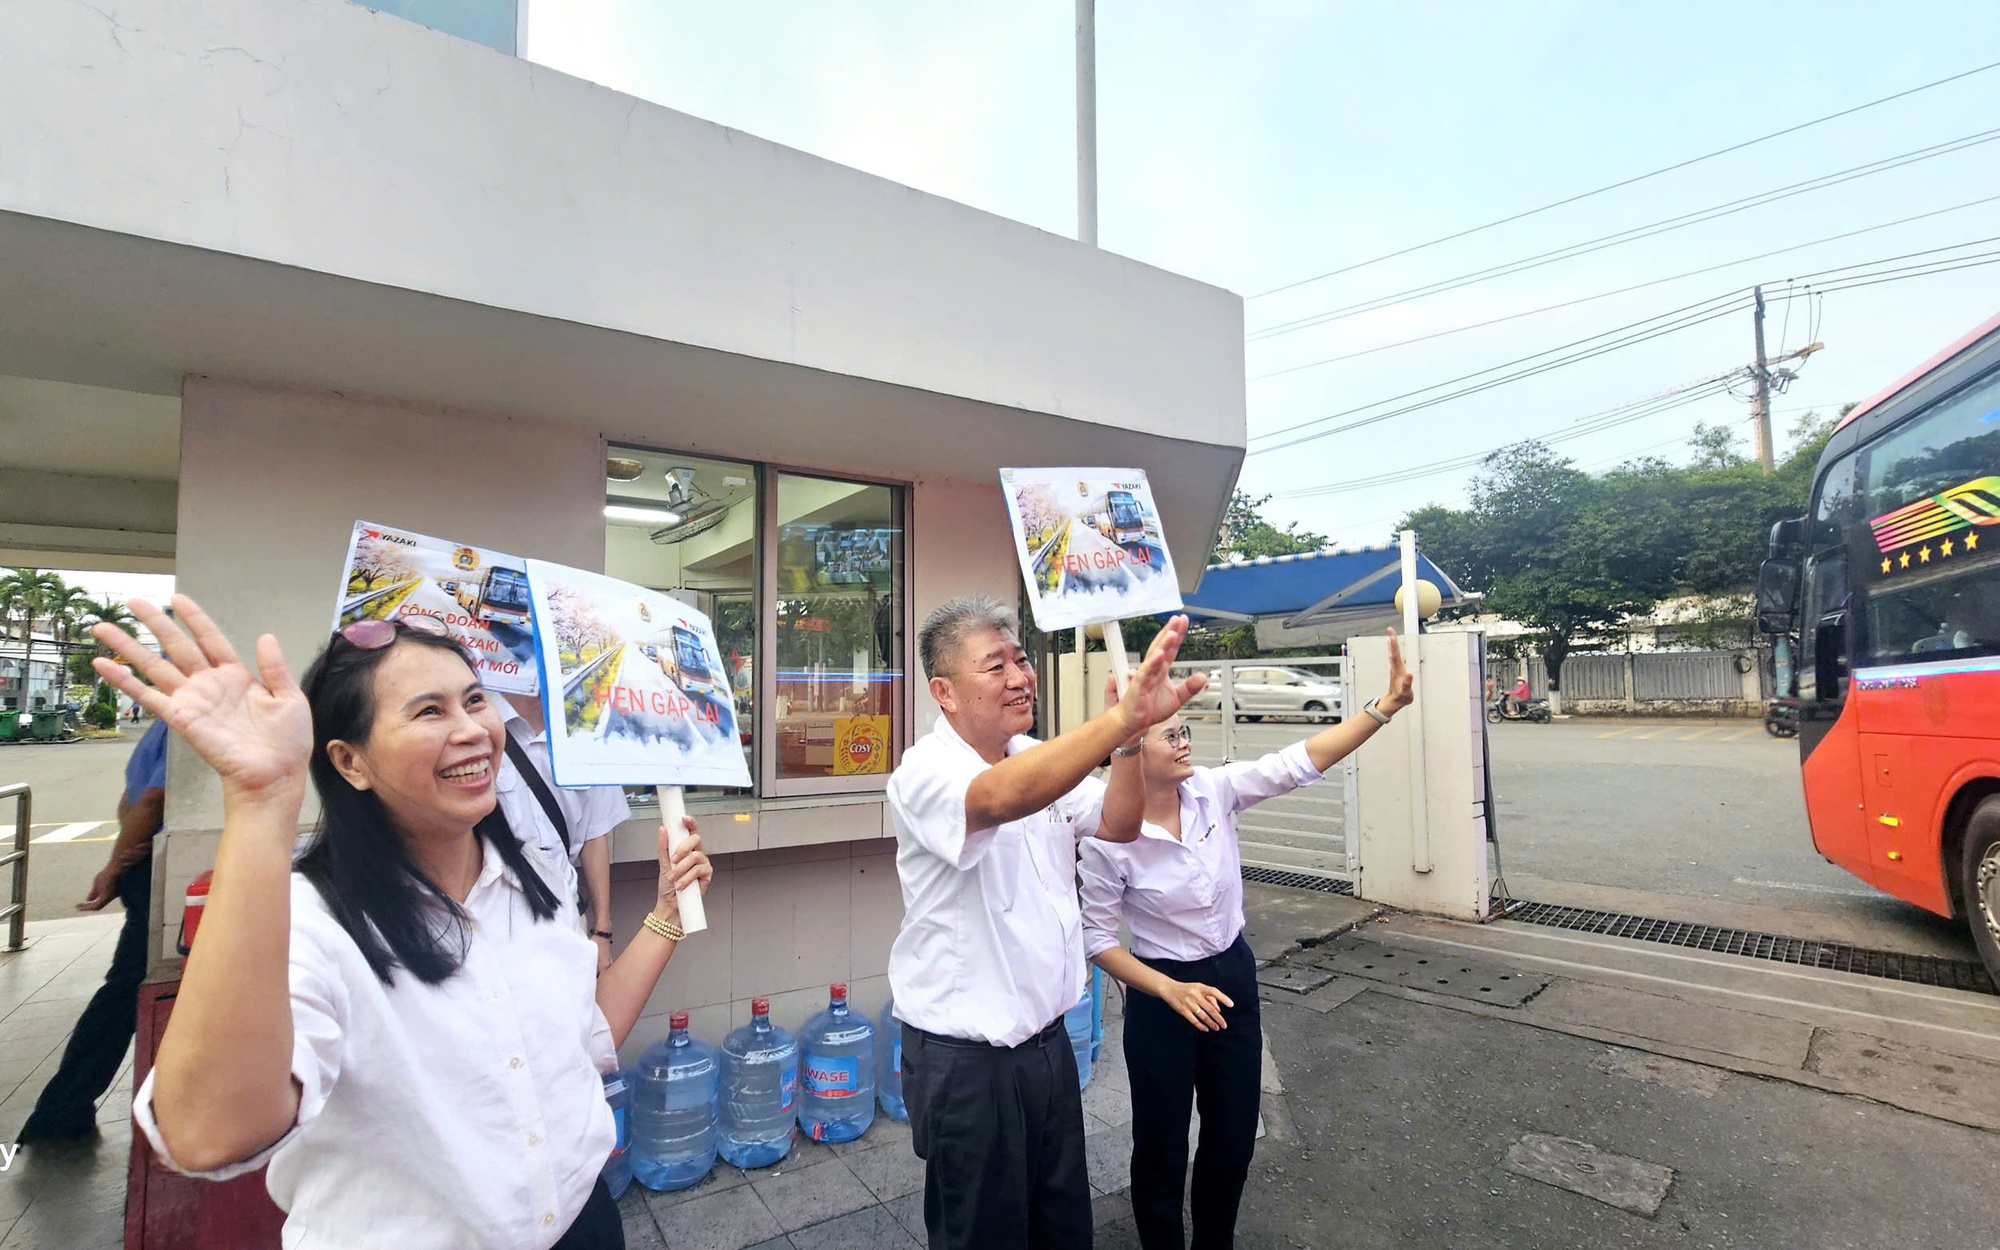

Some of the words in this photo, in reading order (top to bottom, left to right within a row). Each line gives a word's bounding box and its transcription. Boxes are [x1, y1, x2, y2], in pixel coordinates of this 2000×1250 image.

[381, 533, 417, 547] YAZAKI
[1053, 552, 1090, 577] HẸN
[1093, 547, 1125, 571] GẶP
[1128, 546, 1152, 568] LẠI
[488, 660, 519, 675] MỚI
[593, 683, 646, 717] HẸN
[651, 689, 690, 722] GẶP
[694, 700, 720, 728] LẠI
[850, 743, 872, 753] COSY
